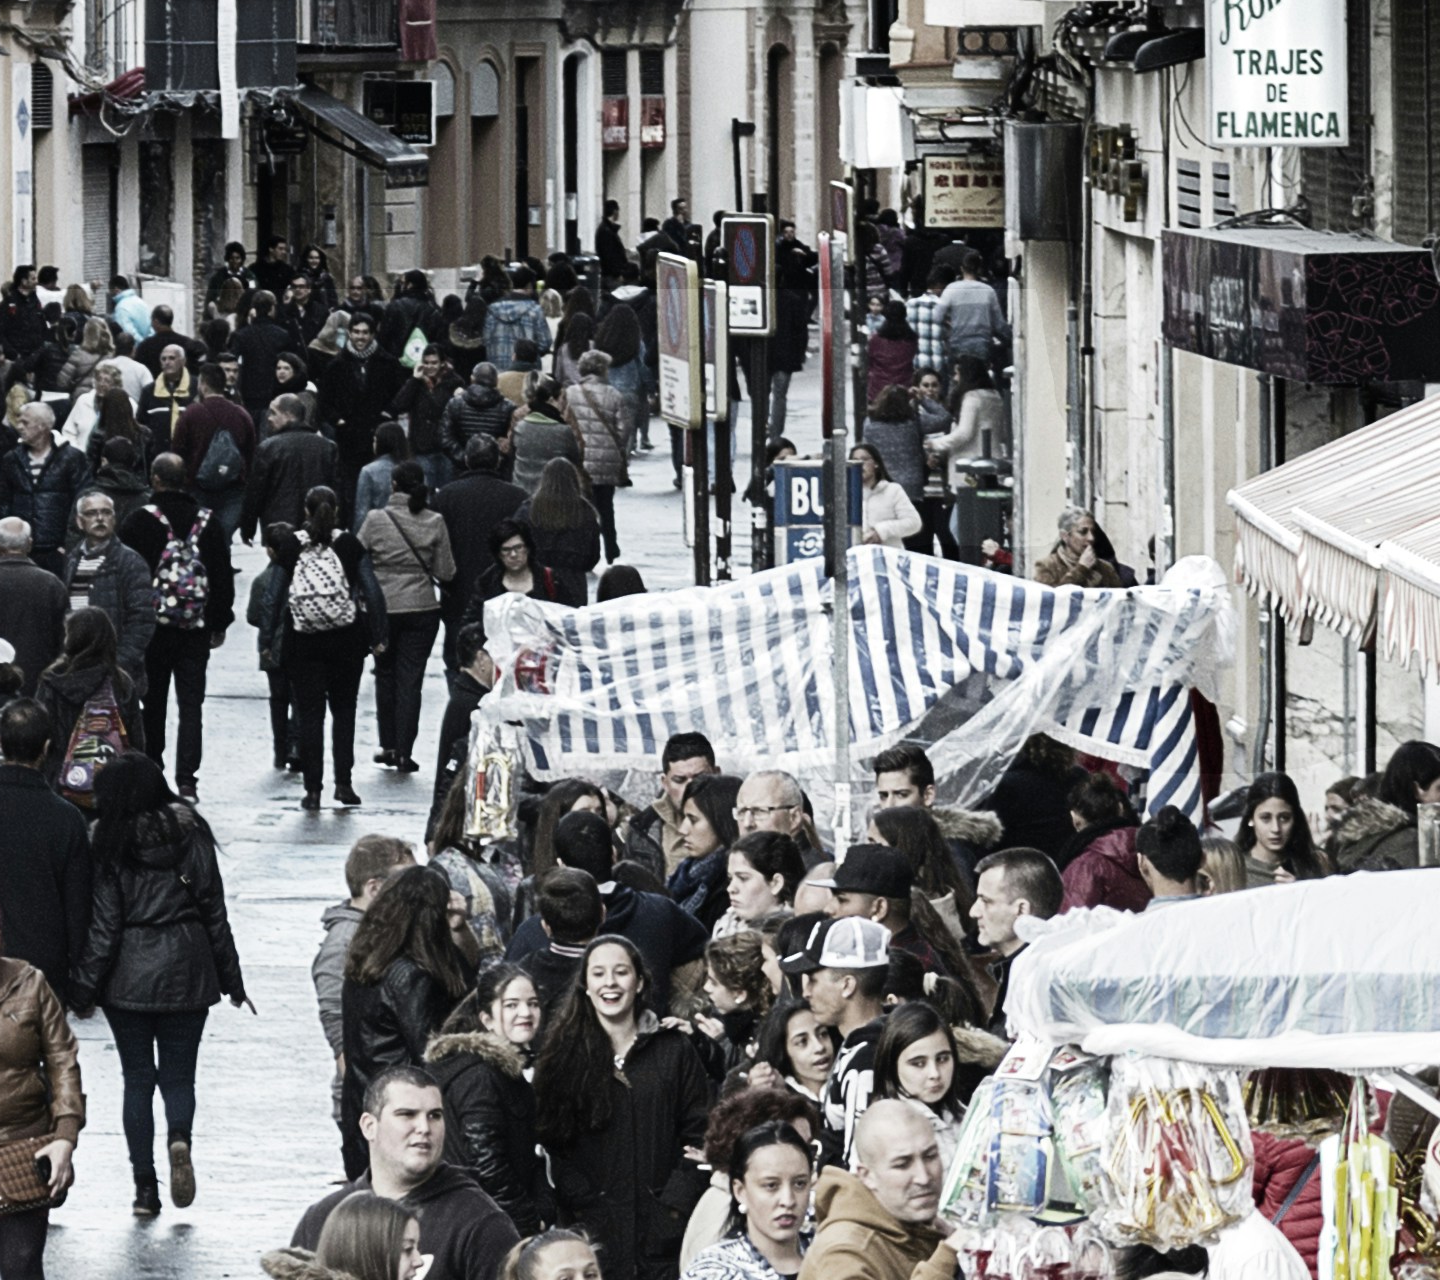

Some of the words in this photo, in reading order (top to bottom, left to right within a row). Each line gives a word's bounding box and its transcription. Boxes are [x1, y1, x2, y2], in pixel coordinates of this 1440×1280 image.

[1233, 48, 1323, 75] TRAJES
[1266, 83, 1288, 103] DE
[1217, 111, 1340, 139] FLAMENCA
[791, 476, 825, 517] BU
